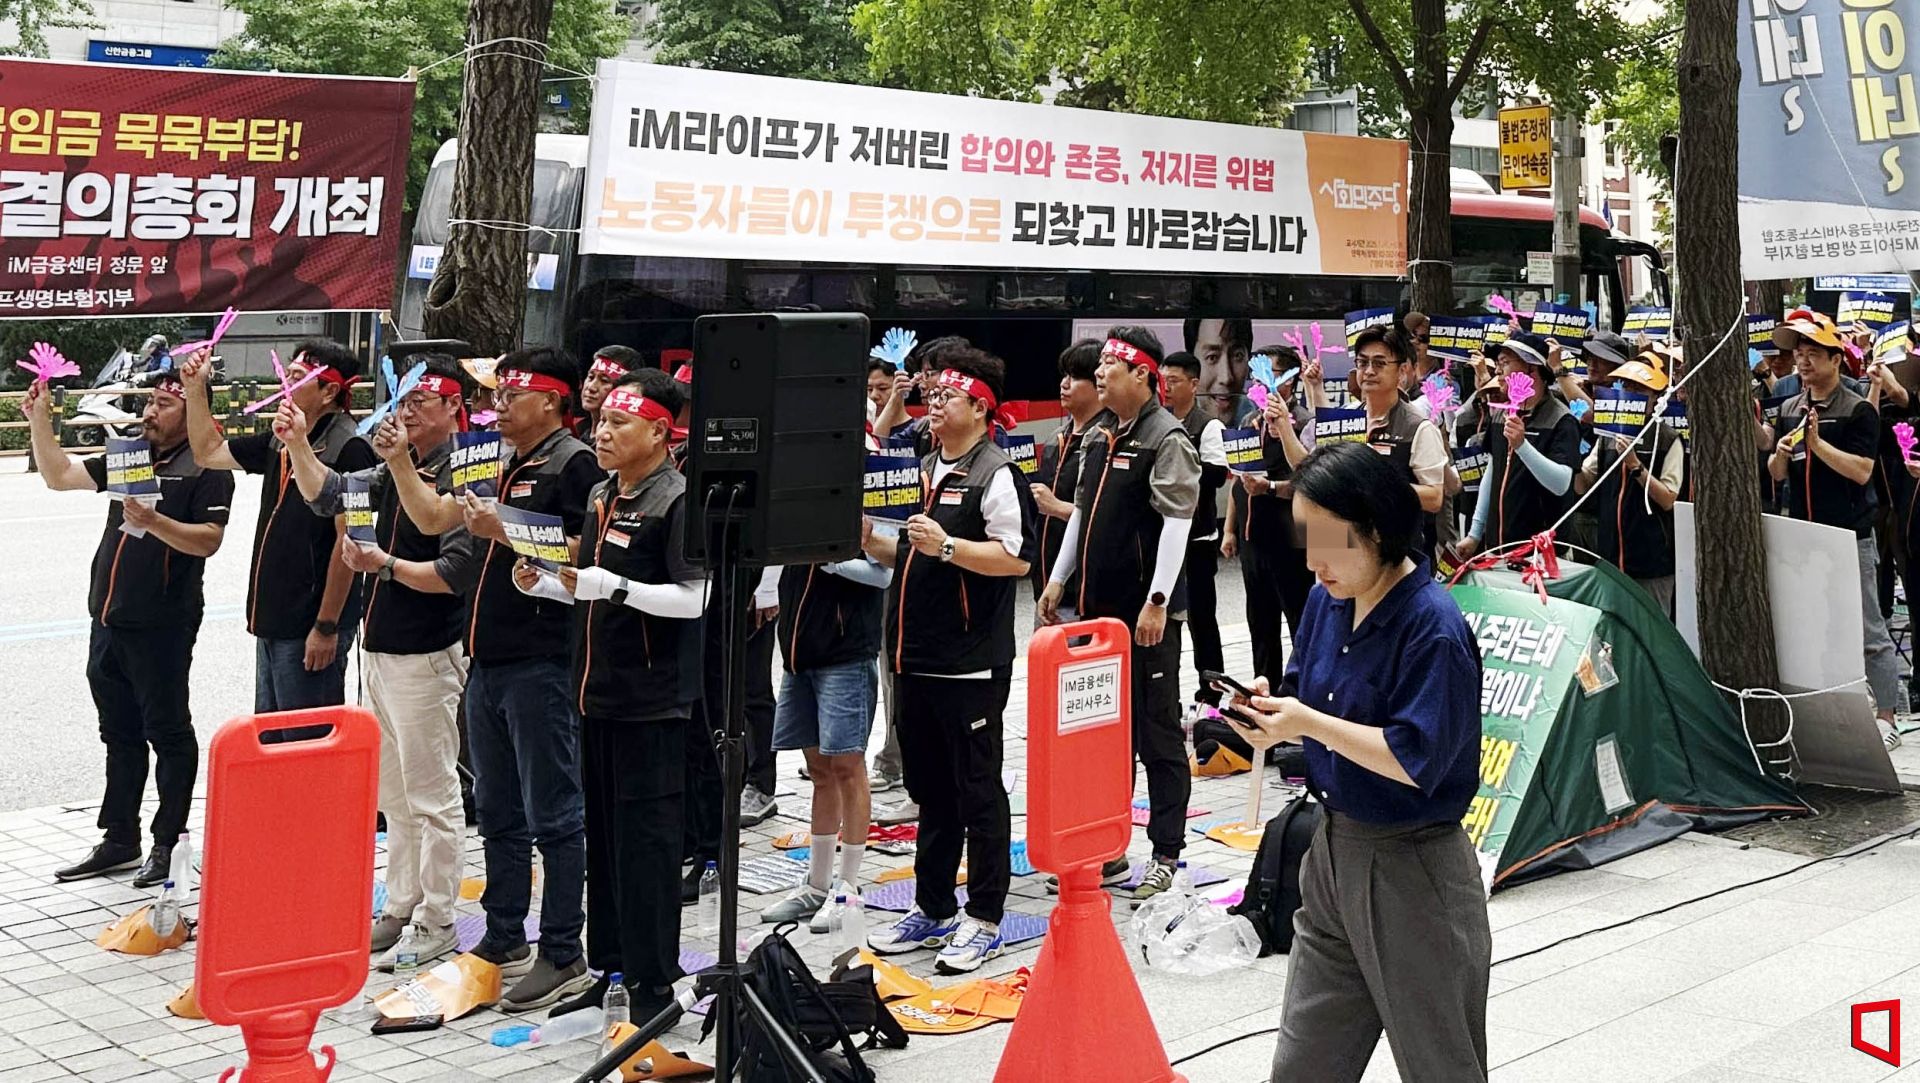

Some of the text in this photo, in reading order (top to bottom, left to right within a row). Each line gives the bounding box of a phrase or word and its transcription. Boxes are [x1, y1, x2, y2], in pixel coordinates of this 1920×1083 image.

[105, 46, 152, 58] 신한금융그룹
[0, 107, 302, 162] 임금 묵묵부답!
[1502, 117, 1548, 144] 불법주정차
[629, 108, 1275, 192] iM라이프가 저버린 합의와 존중, 저지른 위법
[1503, 152, 1548, 178] 무인단속중
[0, 170, 385, 240] 결의총회 개최
[1319, 179, 1401, 215] 사회민주당
[597, 177, 1307, 255] 노동자들이 투쟁으로 되찾고 바로잡습니다
[8, 256, 168, 275] iM금융센터 정문 앞
[1065, 671, 1114, 693] IM금융센터
[1066, 693, 1112, 714] 관리사무소
